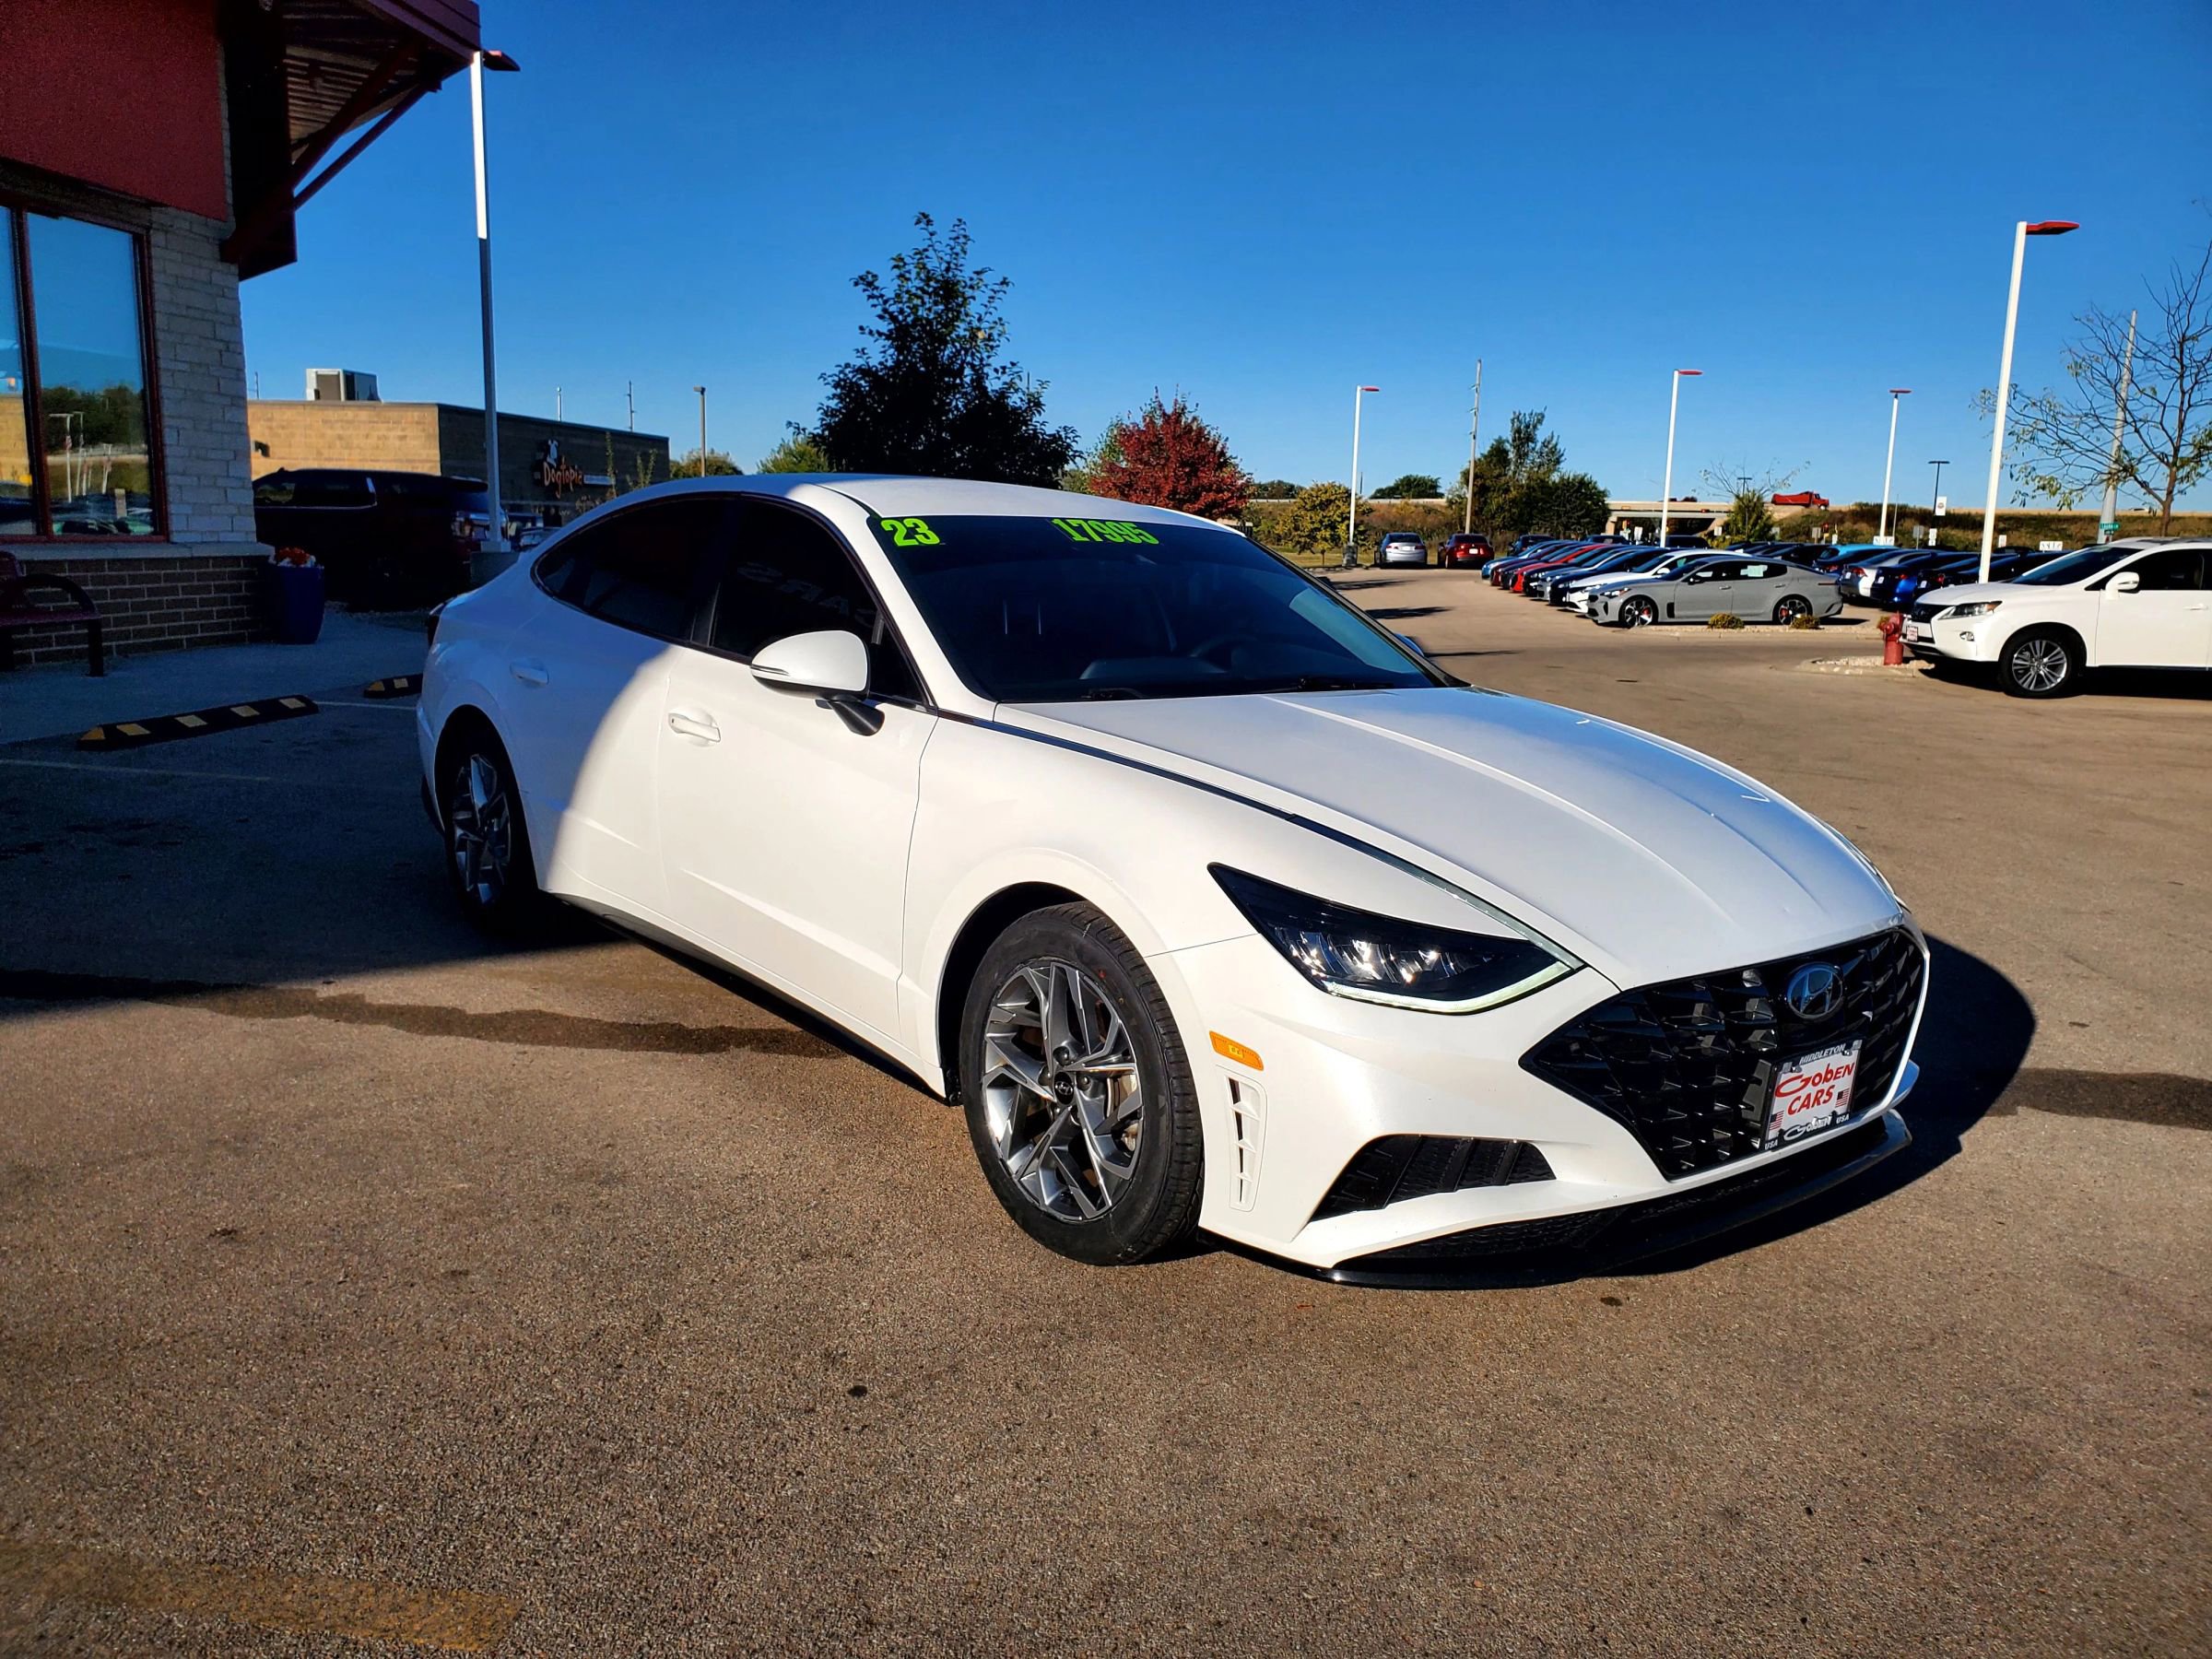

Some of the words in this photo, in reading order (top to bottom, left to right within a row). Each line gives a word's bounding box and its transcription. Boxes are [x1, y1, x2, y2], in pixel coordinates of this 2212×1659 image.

[543, 455, 582, 499] Dogtopia
[880, 518, 940, 547] 23
[1052, 518, 1159, 545] 17995
[1799, 1043, 1846, 1065] MIDDLETON
[1787, 1085, 1835, 1115] CARS
[1764, 1139, 1779, 1150] USA
[1836, 1114, 1850, 1124] USA
